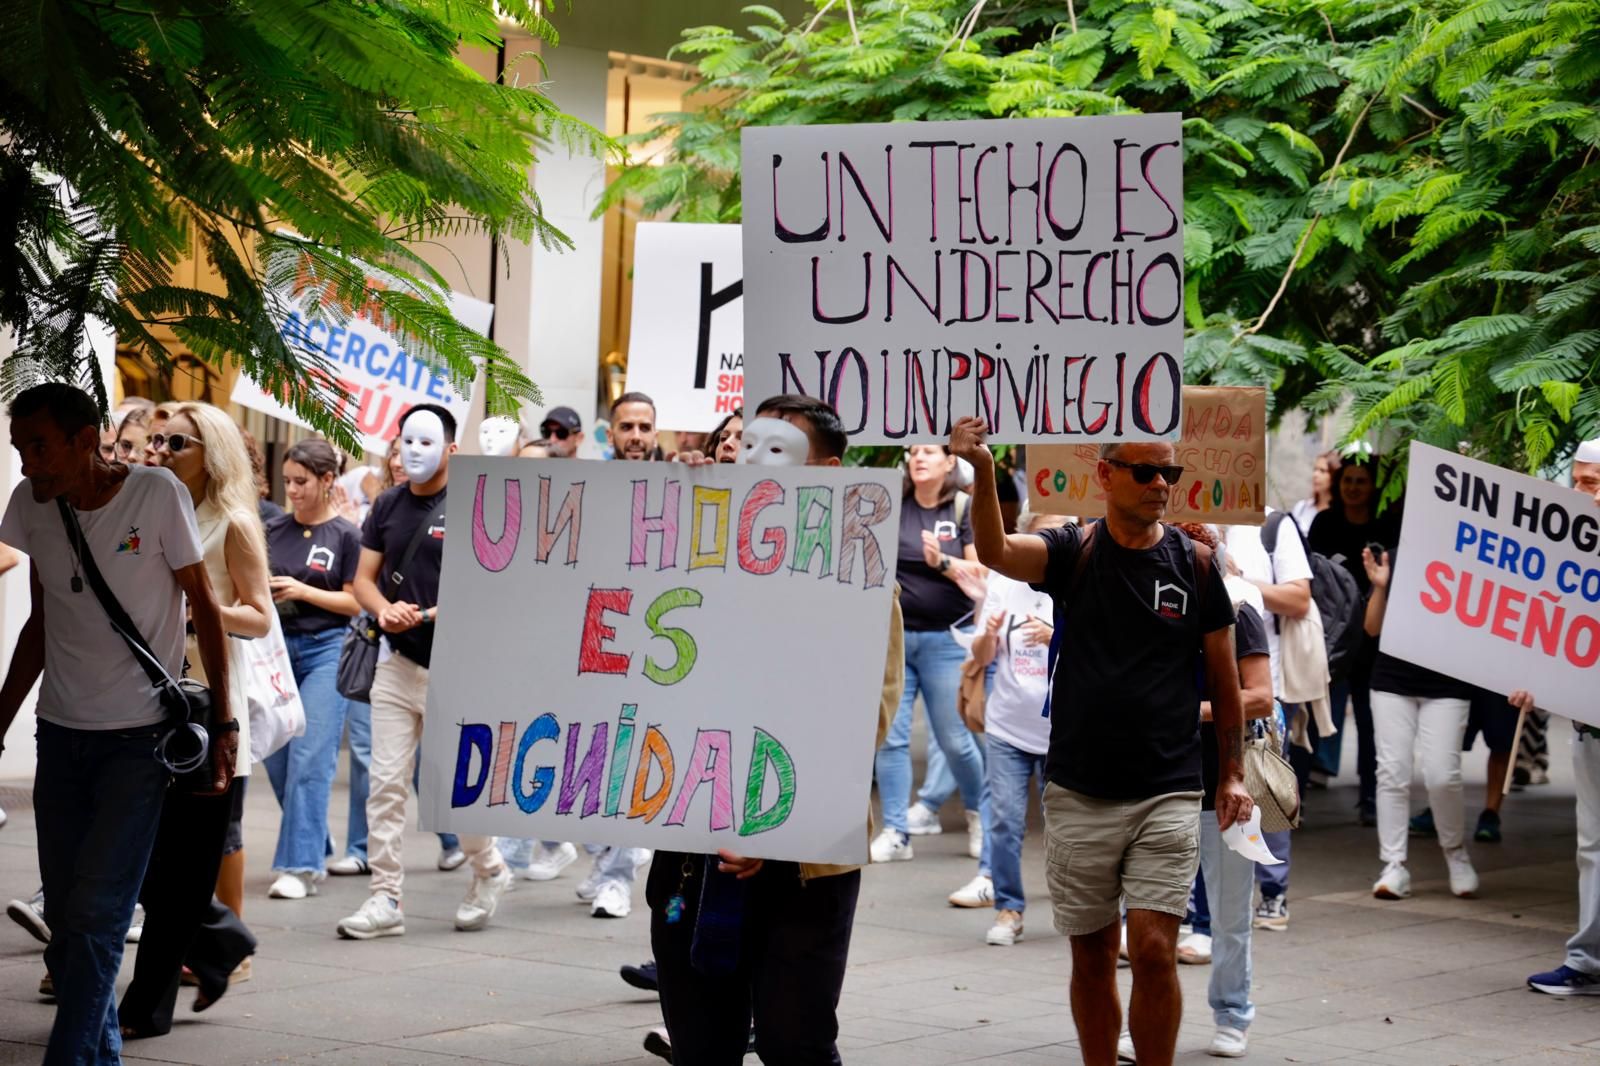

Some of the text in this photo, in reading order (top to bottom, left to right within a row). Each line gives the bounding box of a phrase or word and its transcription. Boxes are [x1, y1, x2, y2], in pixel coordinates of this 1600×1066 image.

[773, 138, 1180, 245] UN TECHO ES
[812, 248, 1181, 326] UN DERECHO
[881, 347, 941, 438] UN
[472, 474, 892, 590] UN HOGAR
[1434, 463, 1600, 557] SIN HOG
[1455, 521, 1600, 603] PERO CO
[578, 583, 703, 686] ES
[1420, 561, 1600, 668] SUEÑO
